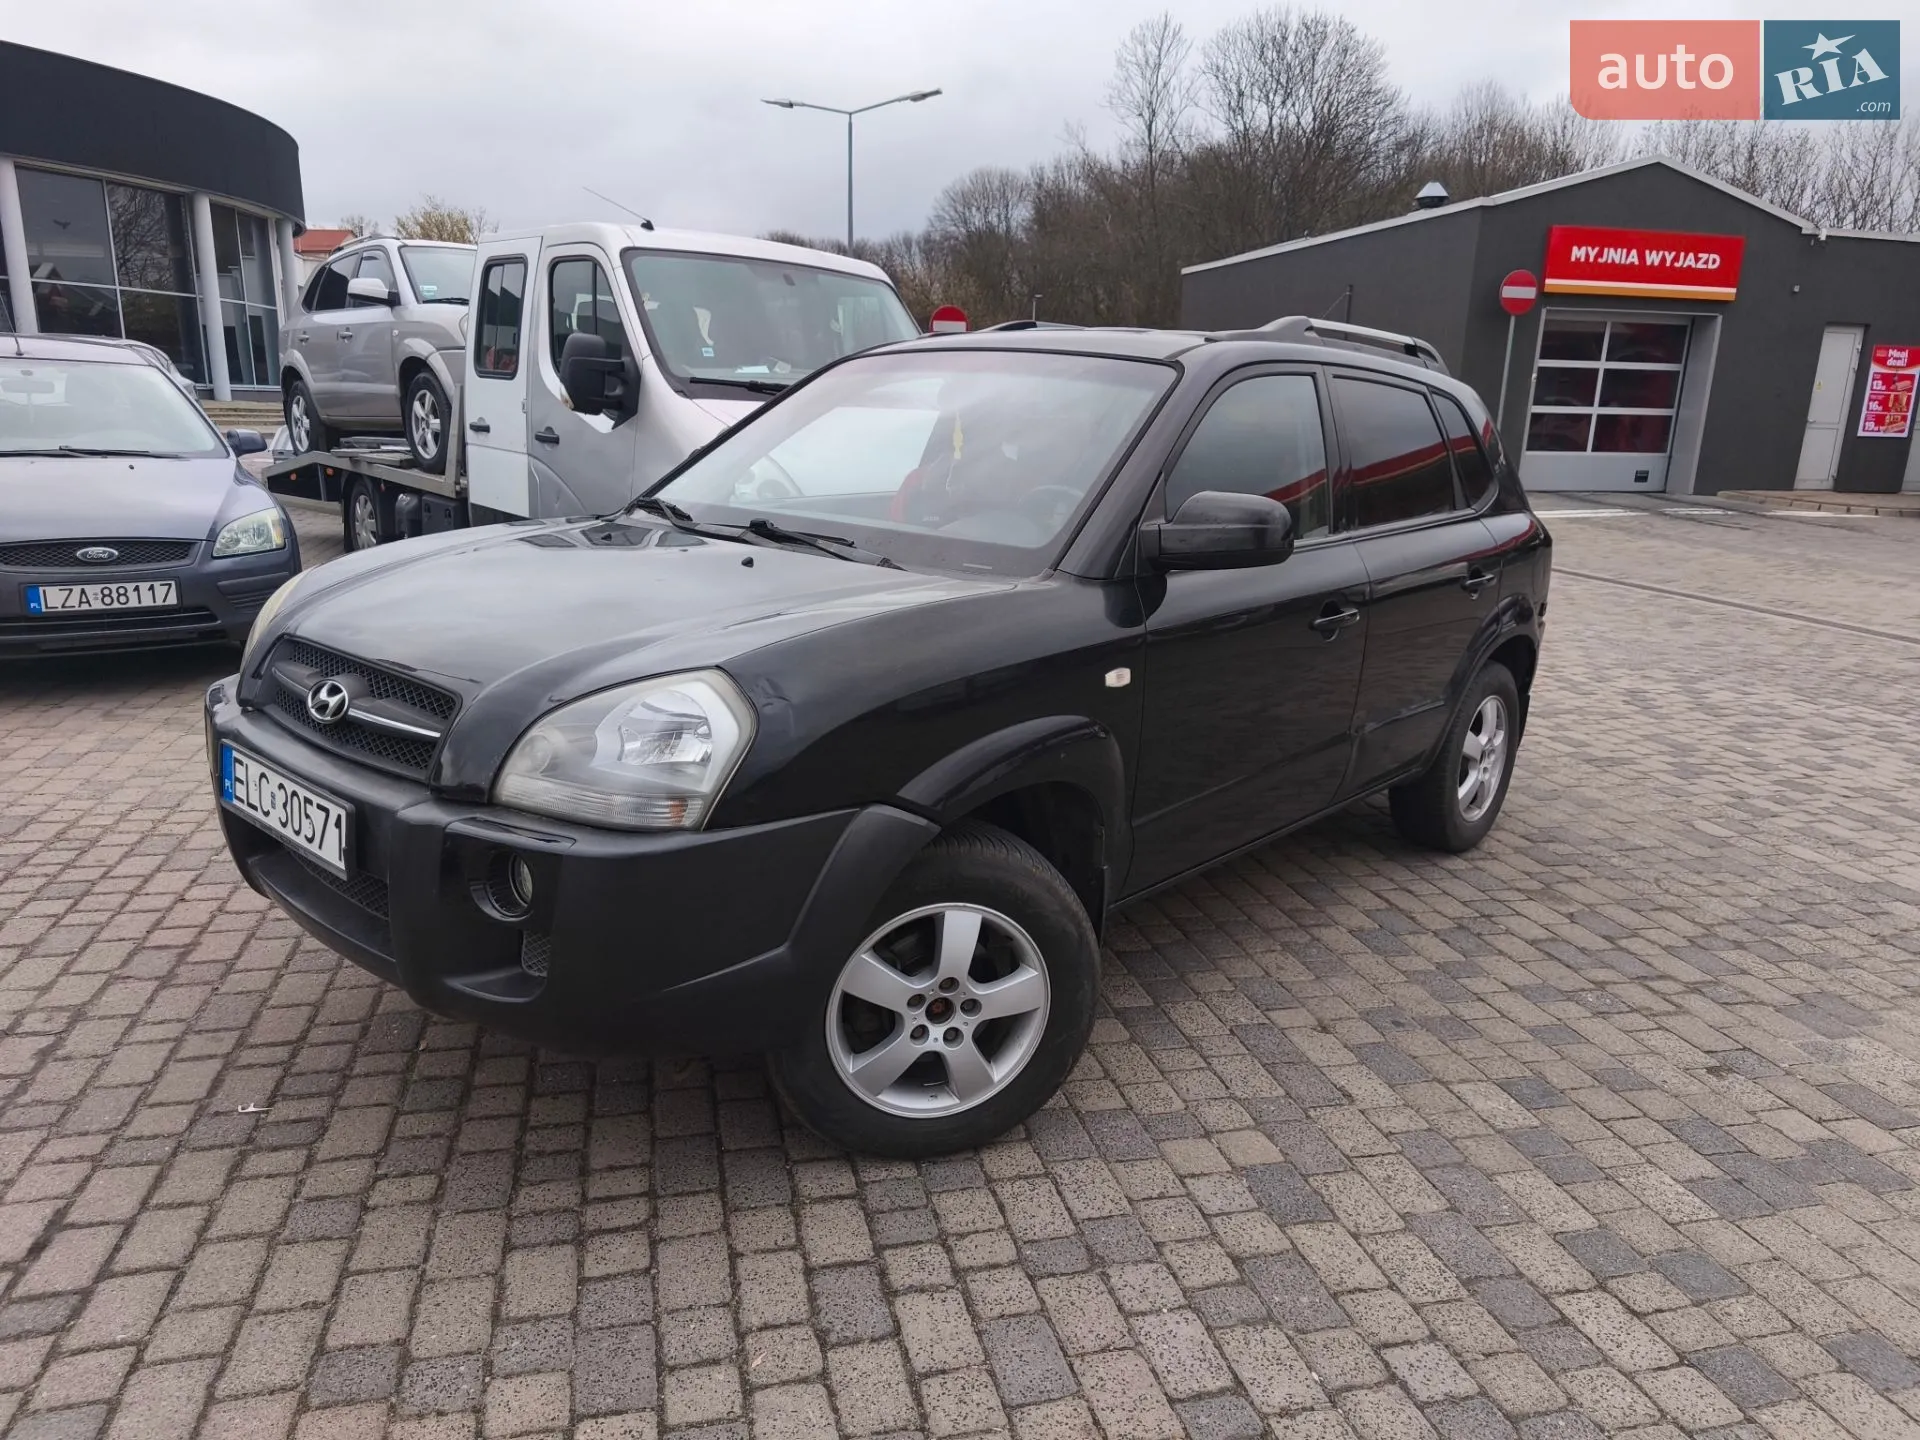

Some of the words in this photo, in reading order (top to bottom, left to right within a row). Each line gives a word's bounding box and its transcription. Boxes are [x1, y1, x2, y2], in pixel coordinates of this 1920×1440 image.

[1570, 246, 1640, 265] MYJNIA
[1644, 249, 1721, 270] WYJAZD
[86, 550, 109, 559] Ford
[42, 587, 93, 610] LZA
[100, 582, 173, 607] 88117
[233, 756, 271, 818] ELC
[277, 782, 343, 862] 30571
